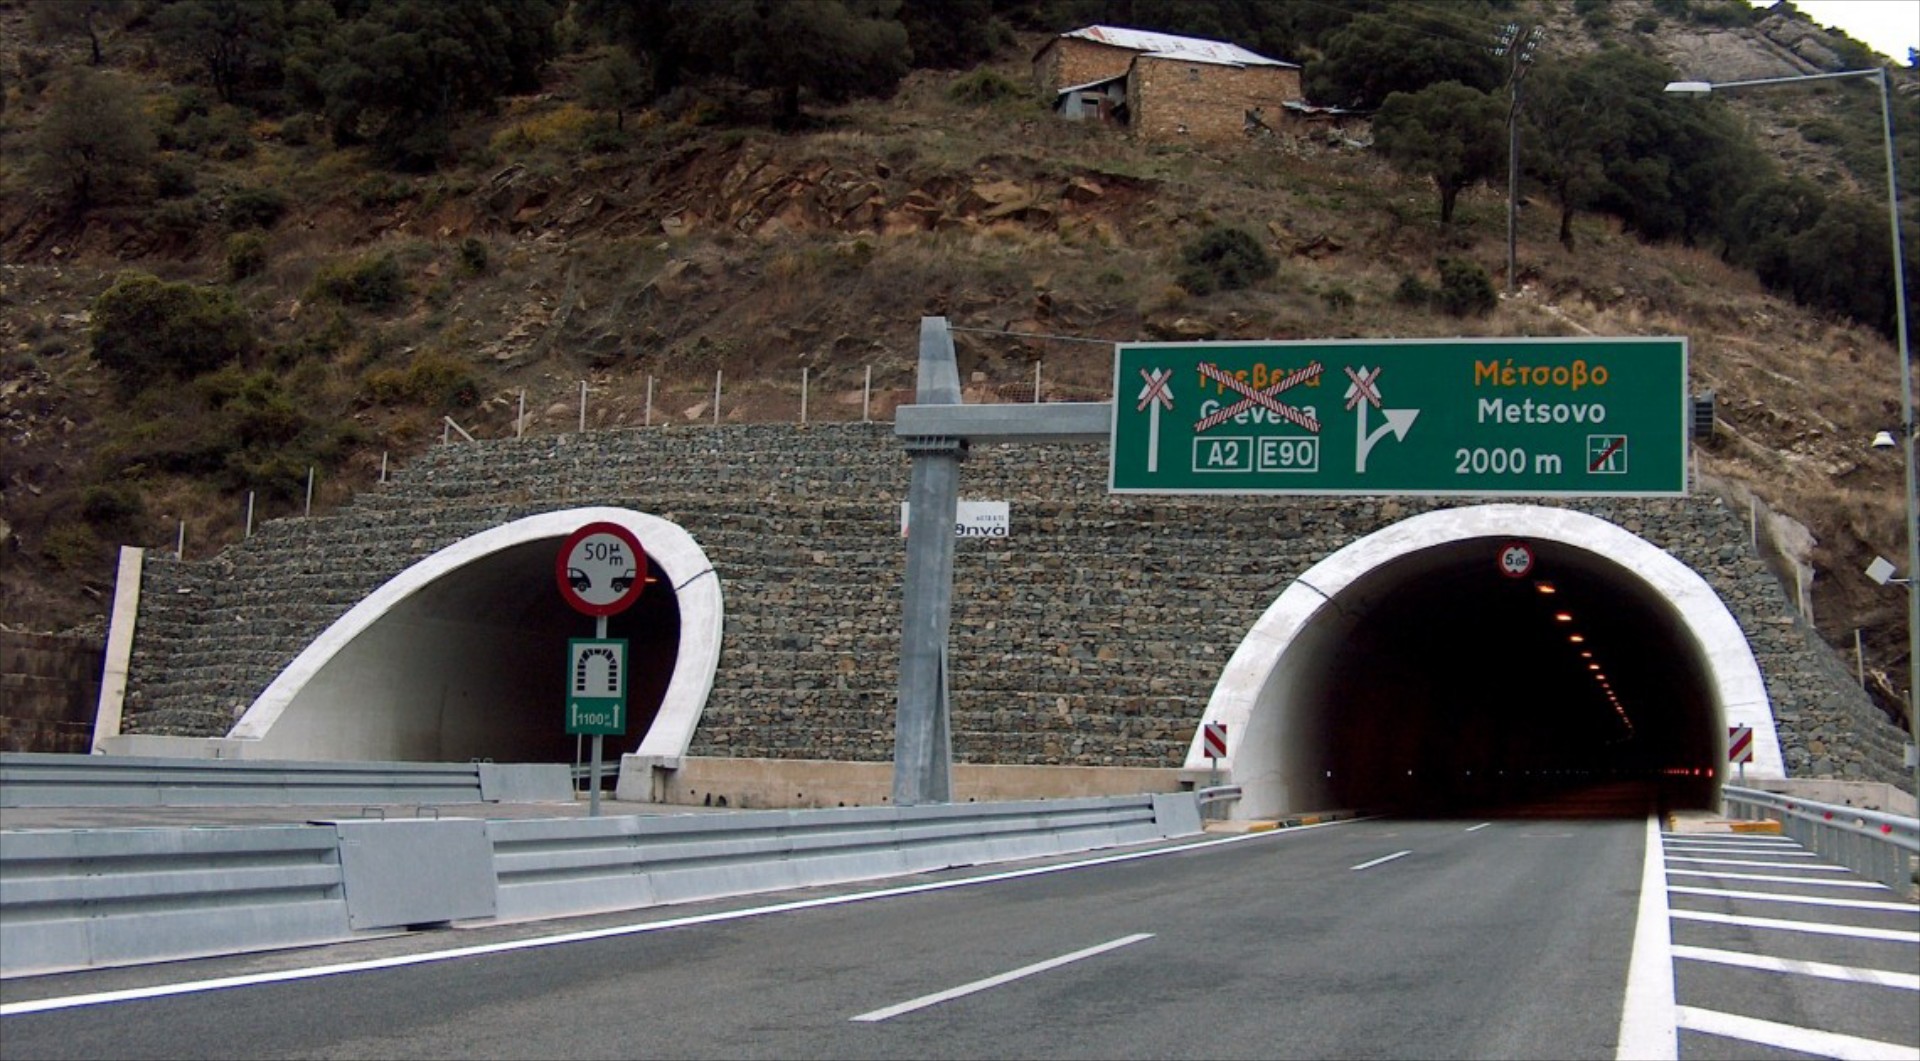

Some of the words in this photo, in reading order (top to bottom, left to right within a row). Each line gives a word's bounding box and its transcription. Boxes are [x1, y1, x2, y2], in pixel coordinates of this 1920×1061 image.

[1474, 358, 1608, 391] Μέτσοβο
[1477, 398, 1606, 424] Metsovo
[1207, 441, 1239, 466] A2
[1263, 441, 1313, 466] E90
[1455, 448, 1526, 474] 2000
[1535, 453, 1562, 474] m
[584, 542, 607, 561] 50
